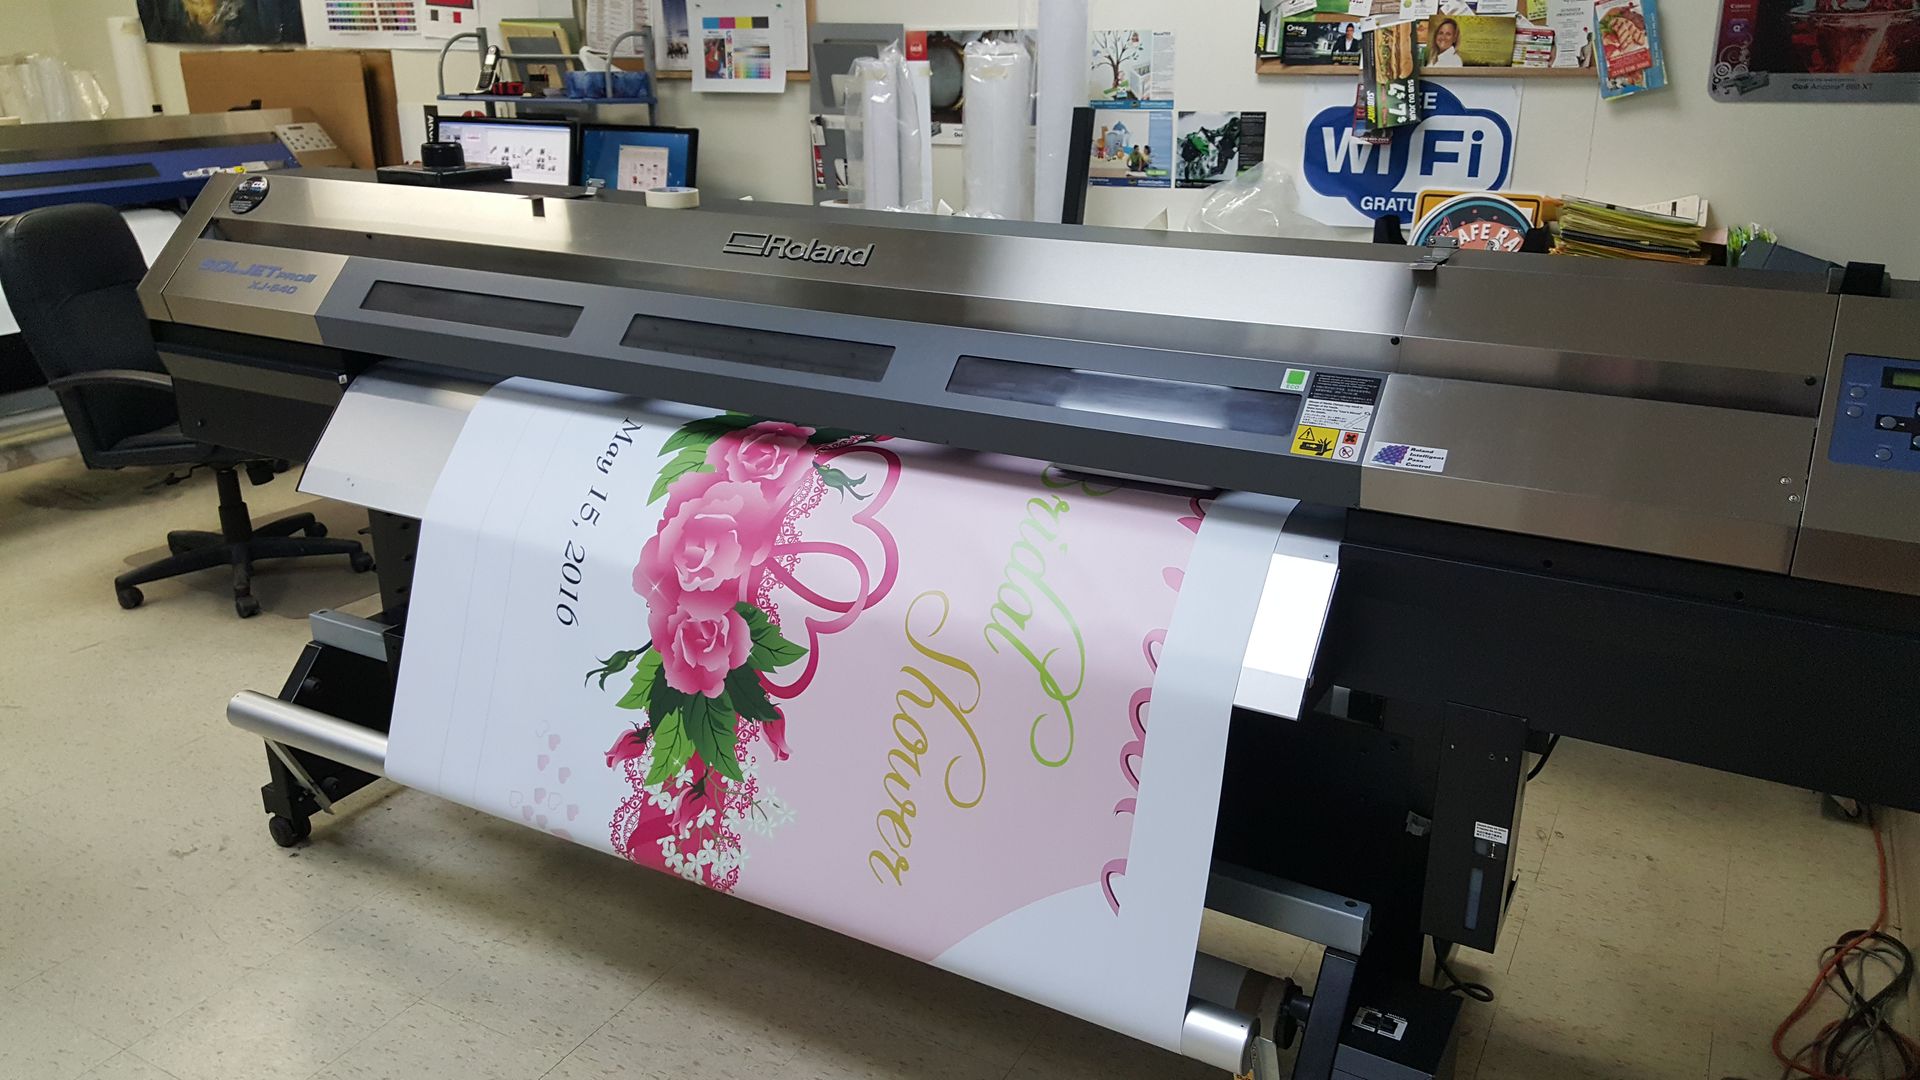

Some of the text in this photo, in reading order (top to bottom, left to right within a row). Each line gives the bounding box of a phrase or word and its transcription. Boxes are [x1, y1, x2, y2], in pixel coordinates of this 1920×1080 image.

[1366, 91, 1376, 123] SUBWAY
[763, 234, 876, 267] Roland
[1457, 223, 1491, 246] AFE
[1409, 452, 1445, 461] Intelligent
[556, 416, 644, 627] May 15, 2016
[867, 590, 987, 886] Shower
